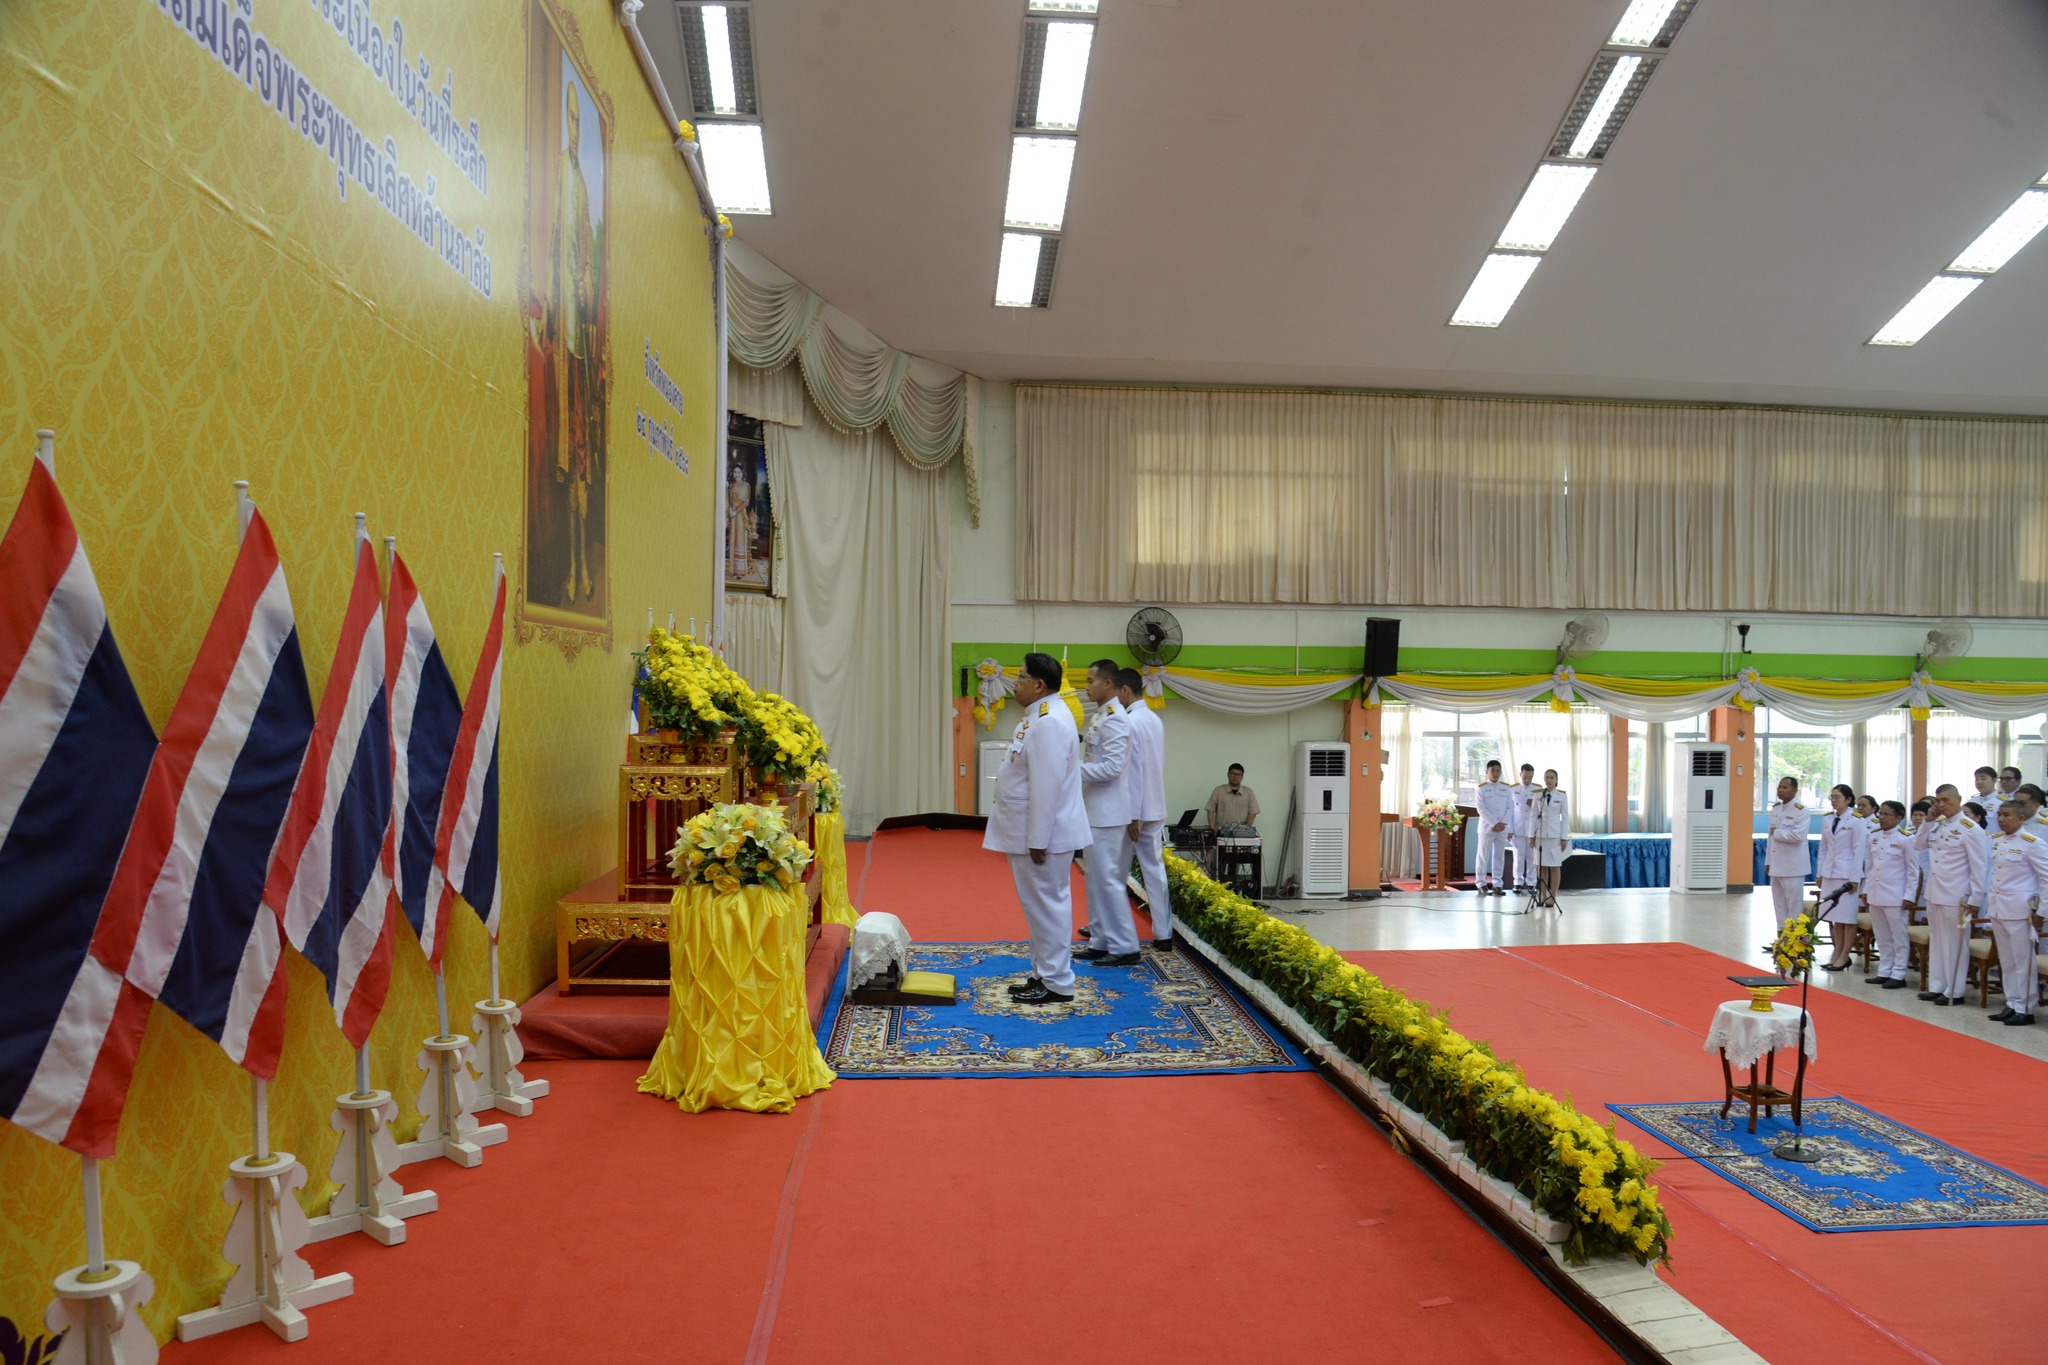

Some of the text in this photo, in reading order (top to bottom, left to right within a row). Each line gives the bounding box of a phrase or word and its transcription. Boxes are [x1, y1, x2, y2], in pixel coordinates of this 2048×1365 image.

[159, 0, 492, 297] มเด็จพระพุทธเลิศหล้านภาลัย
[649, 418, 673, 462] กุมภาพันธ์
